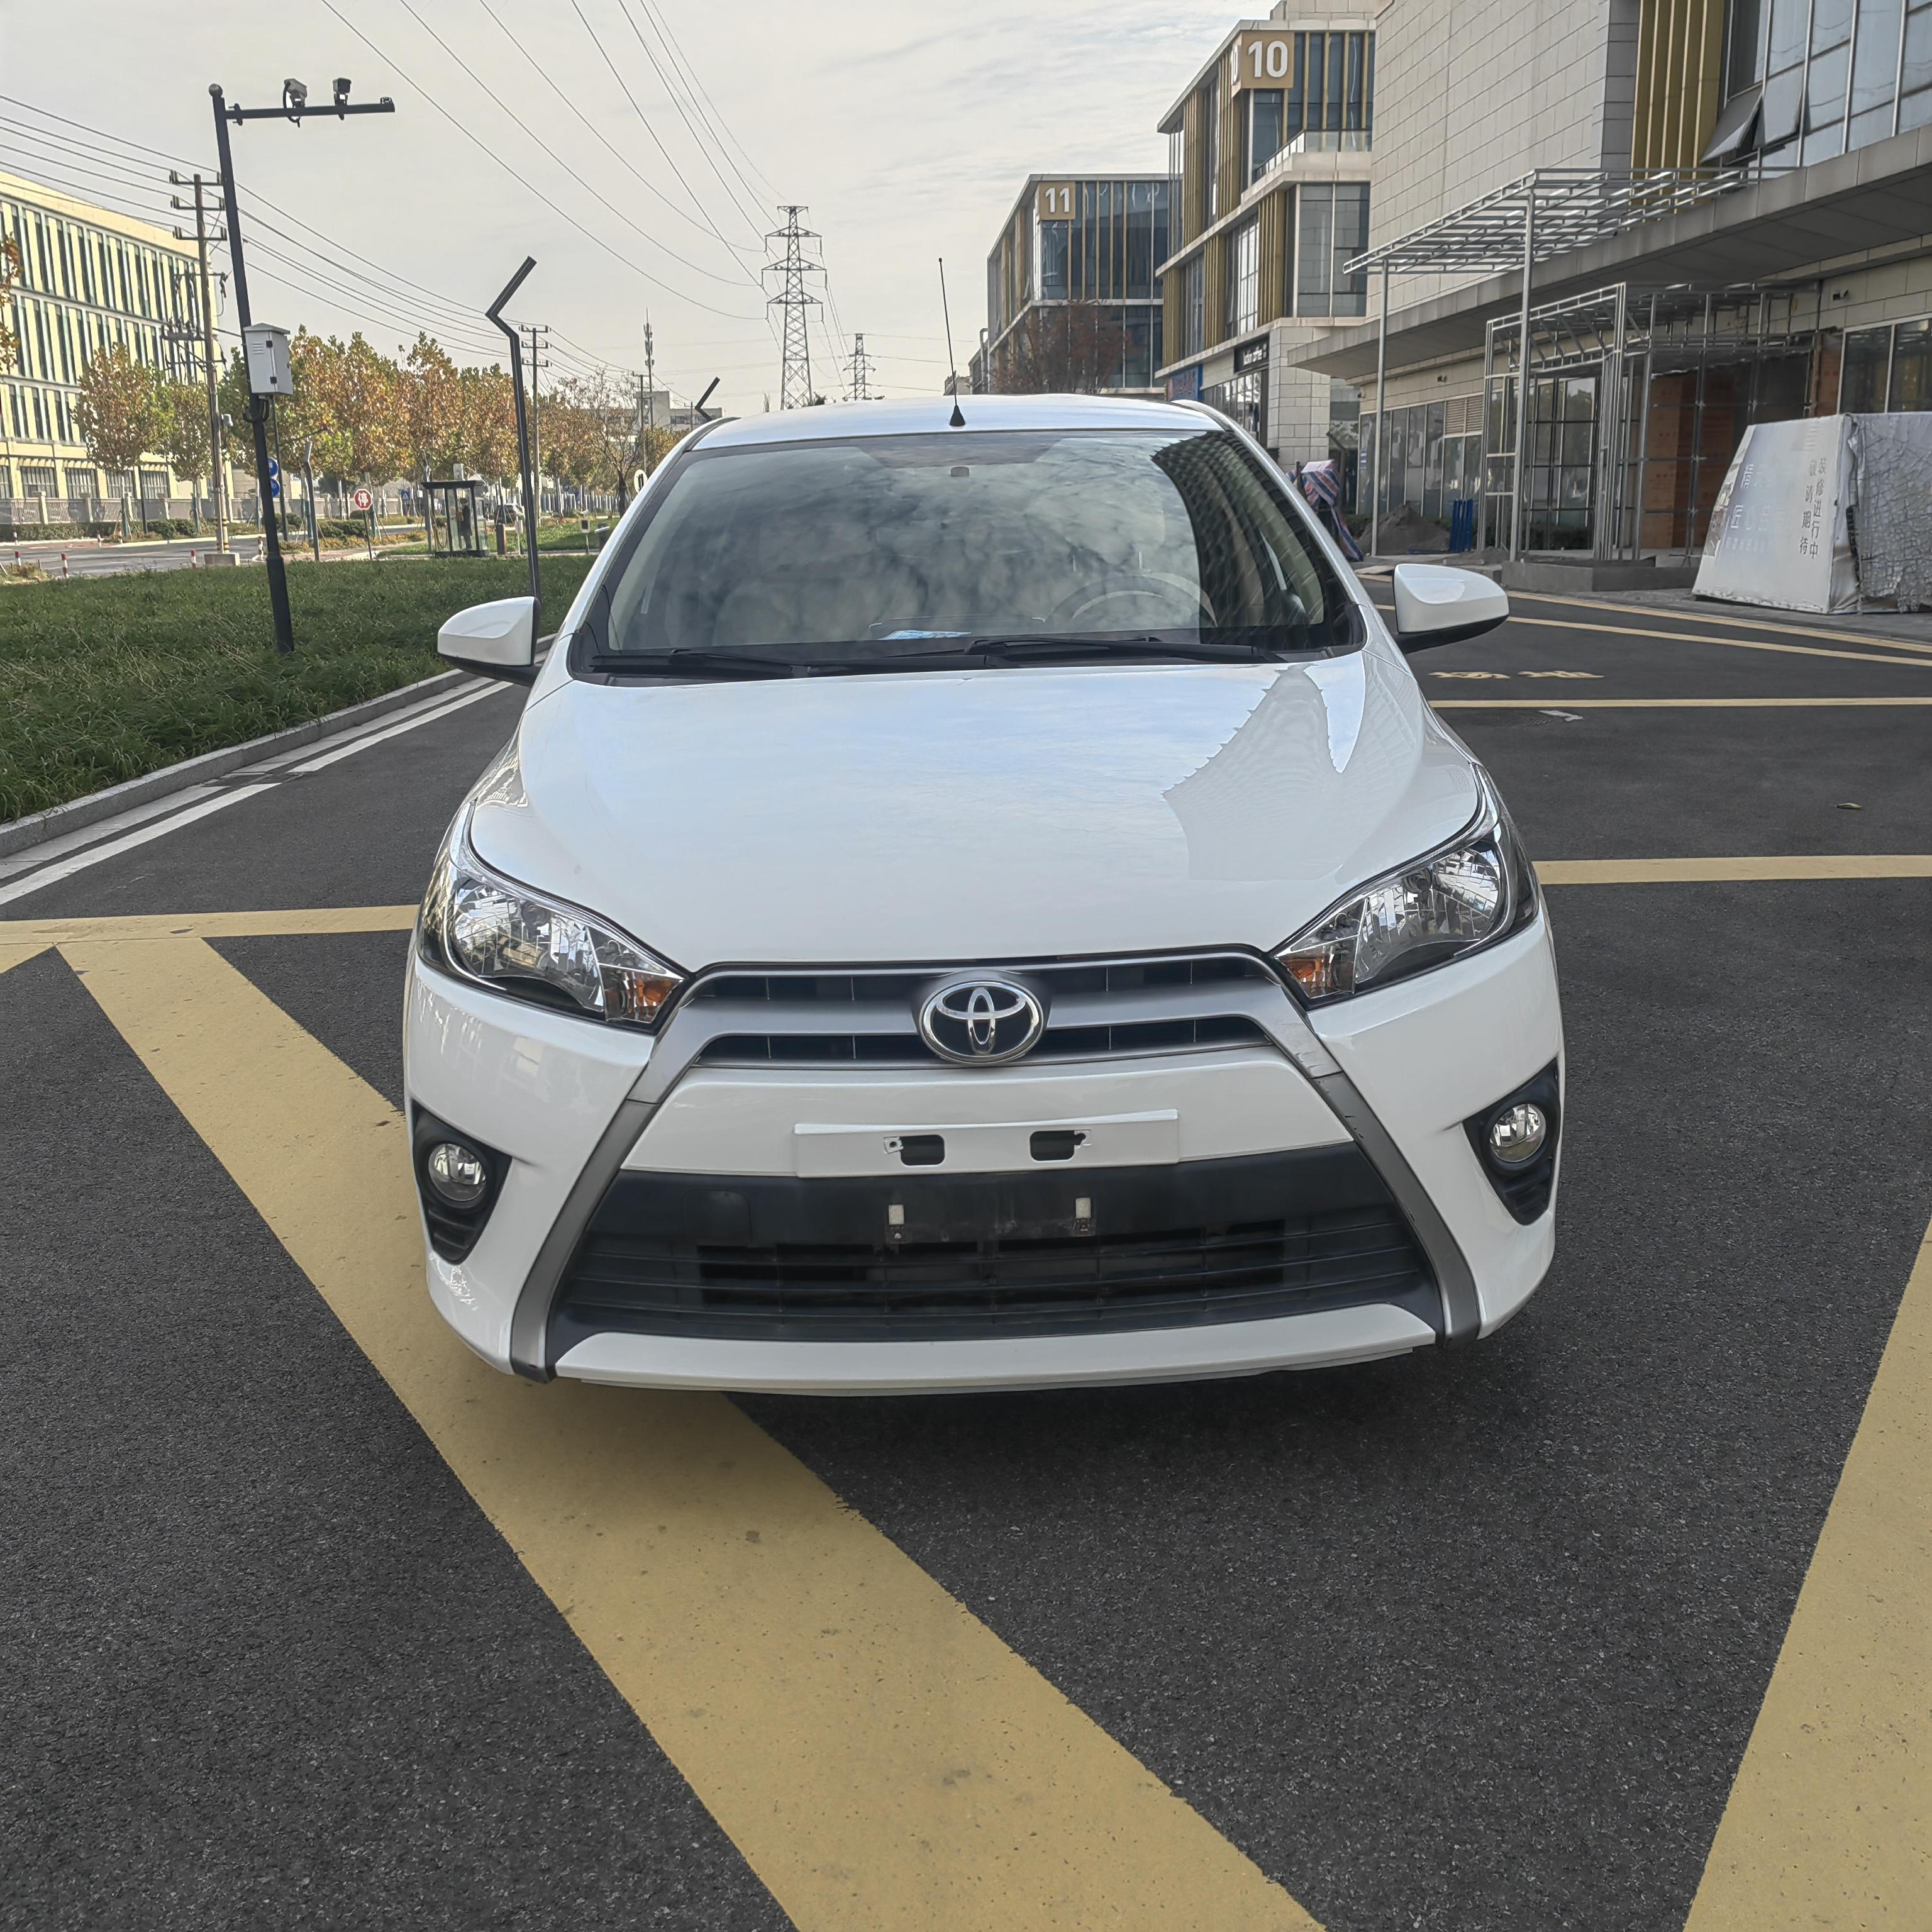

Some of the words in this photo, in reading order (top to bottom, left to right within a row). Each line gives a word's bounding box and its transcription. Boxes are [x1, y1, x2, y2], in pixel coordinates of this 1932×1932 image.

[1248, 41, 1288, 77] 10
[1045, 187, 1069, 213] 11
[358, 492, 369, 507] 停
[1809, 458, 1826, 559] 装修进行中
